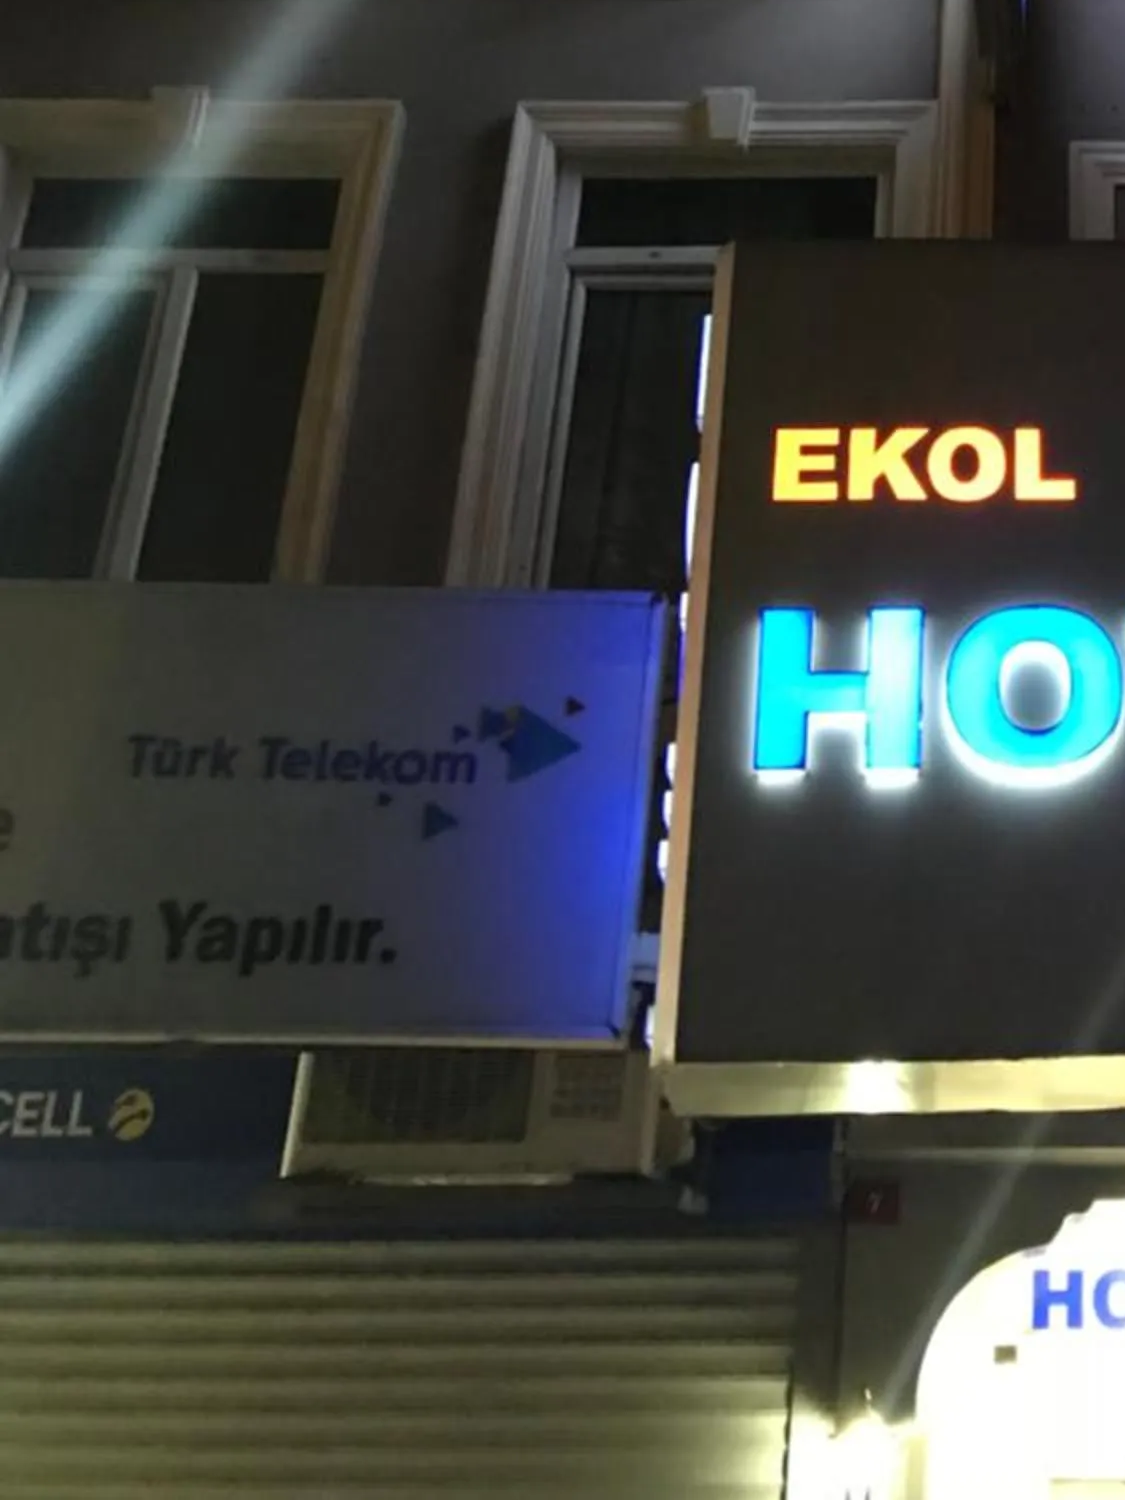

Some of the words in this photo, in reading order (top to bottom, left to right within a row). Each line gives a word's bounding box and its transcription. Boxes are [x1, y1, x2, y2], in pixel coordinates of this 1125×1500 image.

[772, 426, 1078, 503] EKOL
[128, 735, 240, 780] Türk
[259, 737, 479, 786] Telekom
[158, 900, 397, 977] Yapılır.
